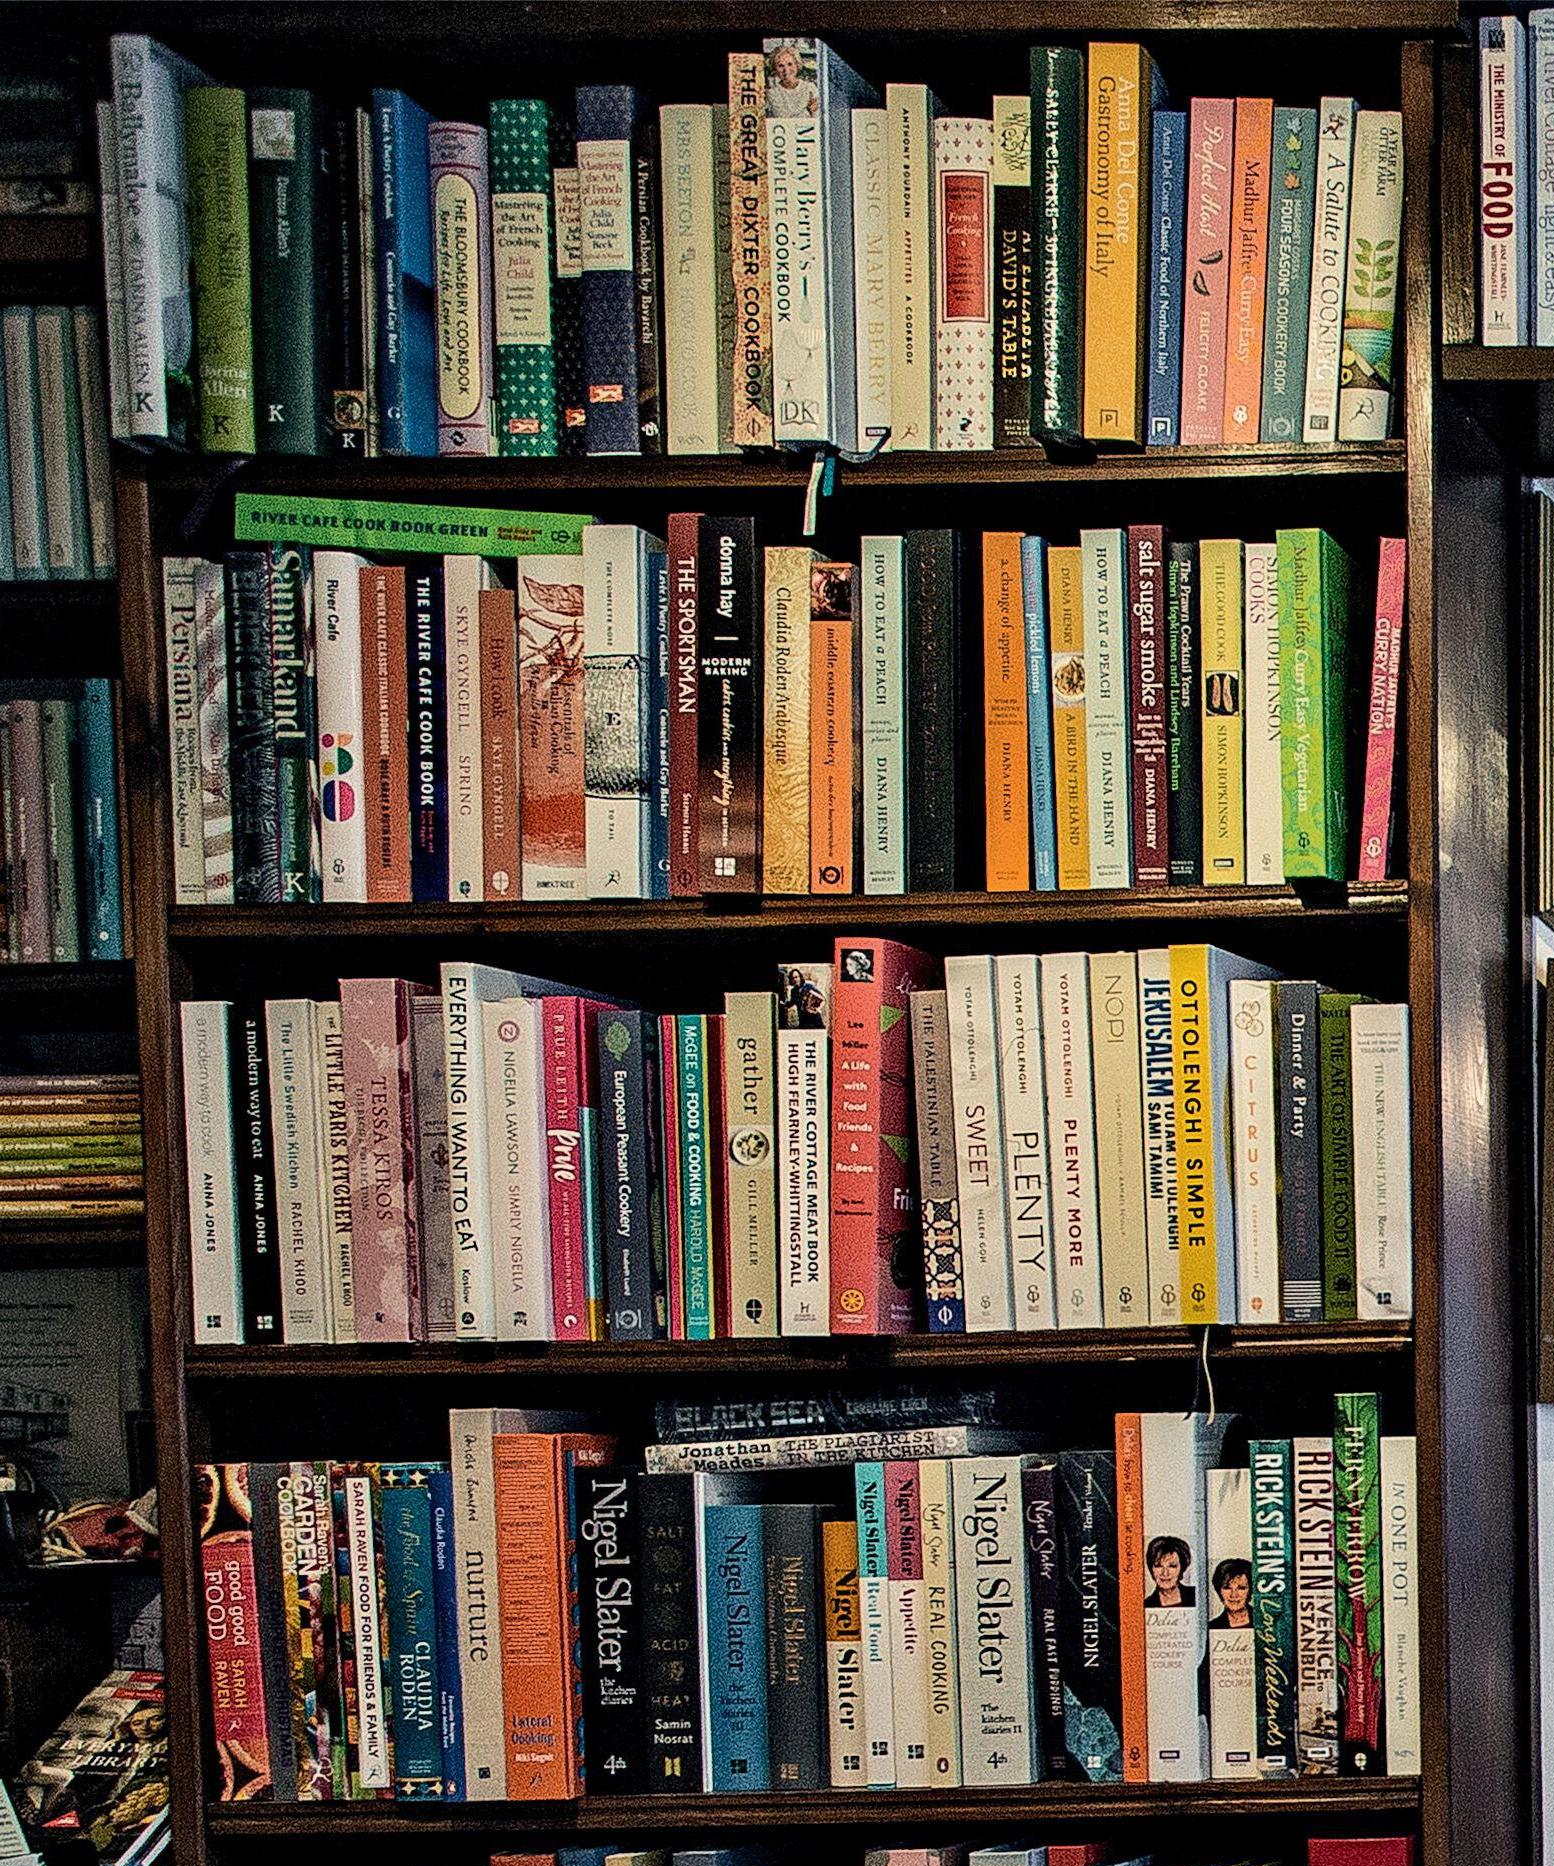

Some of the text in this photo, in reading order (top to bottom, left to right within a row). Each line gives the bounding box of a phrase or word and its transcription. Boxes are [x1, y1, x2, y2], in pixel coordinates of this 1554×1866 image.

[792, 123, 814, 183] Mary
[1491, 64, 1505, 158] THE MINISTRY OF
[740, 64, 762, 411] THE GREAT DIXTER COOKBOOK
[770, 123, 792, 324] COMPLETE COOKBOOK
[1484, 162, 1514, 239] FOOD
[718, 535, 735, 619] donna hay
[1132, 540, 1156, 707] salt sugar smoke
[267, 548, 308, 740] Samarkand
[675, 556, 698, 713] THE SPORTSMAN
[702, 657, 751, 667] MODERN
[705, 666, 747, 676] BAKING
[417, 578, 436, 807] THE RIVER CAFE COOK BOOK
[448, 976, 469, 1104] EVERYTHING
[1104, 976, 1125, 1043] NOPI
[1143, 978, 1174, 1097] JERUSALEM
[737, 1038, 759, 1116] gather
[1181, 980, 1207, 1247] OTTOLENGHI SIMPLE
[451, 1119, 470, 1182] WANT
[547, 1128, 583, 1182] prue
[965, 1106, 991, 1187] SWEET
[1063, 1118, 1084, 1268] PLENTY MORE
[453, 1184, 471, 1213] TO
[455, 1218, 480, 1254] EAT
[1012, 1131, 1046, 1272] PLENTY
[1253, 1454, 1276, 1494] RICK
[465, 1551, 489, 1662] nurture
[581, 1480, 632, 1672] Nigel Slater
